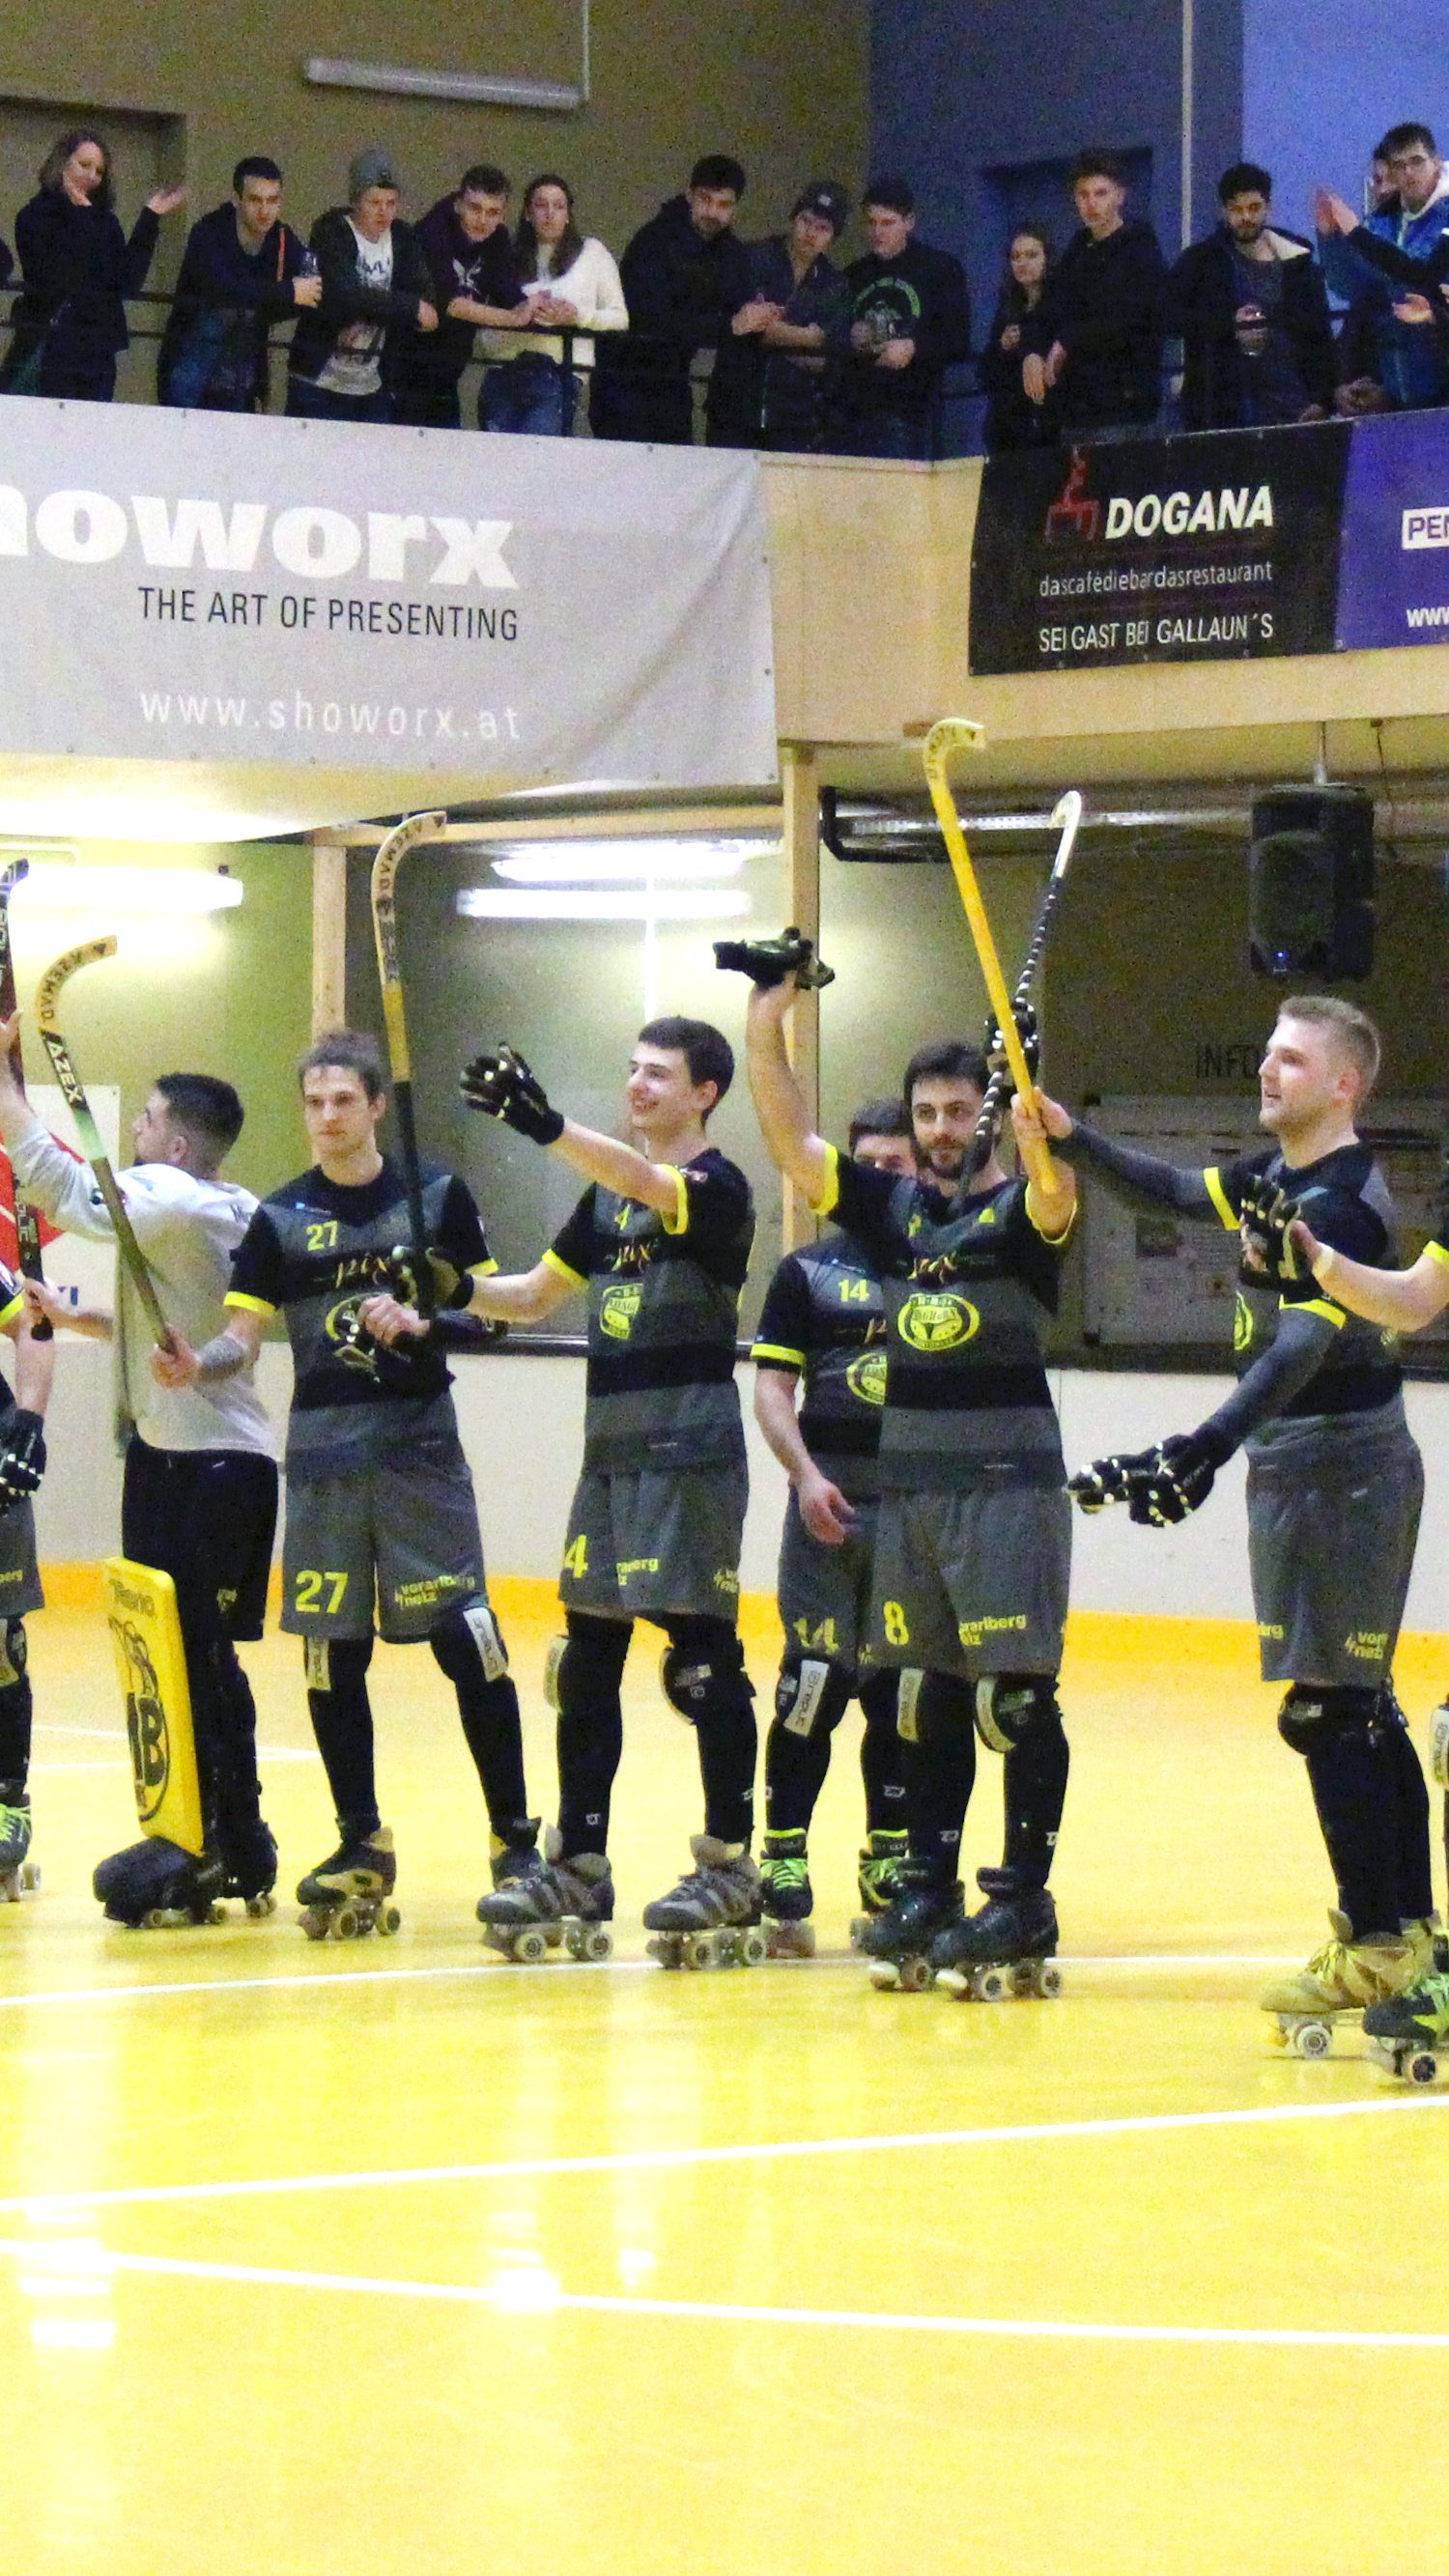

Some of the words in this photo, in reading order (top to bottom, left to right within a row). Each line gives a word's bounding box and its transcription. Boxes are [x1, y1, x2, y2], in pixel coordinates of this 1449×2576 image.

[1104, 485, 1274, 540] DOGANA
[138, 586, 196, 623] THE
[207, 592, 269, 627] ART
[281, 596, 317, 630] OF
[328, 598, 519, 641] PRESENTING
[1039, 626, 1065, 654] SEI
[1071, 623, 1120, 649] GAST
[1126, 622, 1149, 647] BEI
[140, 690, 520, 740] www.showorx.at
[46, 1039, 83, 1104] AZEX
[305, 1220, 338, 1252] 27
[838, 1278, 869, 1303] 14
[564, 1534, 588, 1579] 4
[296, 1569, 349, 1614] 27
[883, 1600, 910, 1646] 8
